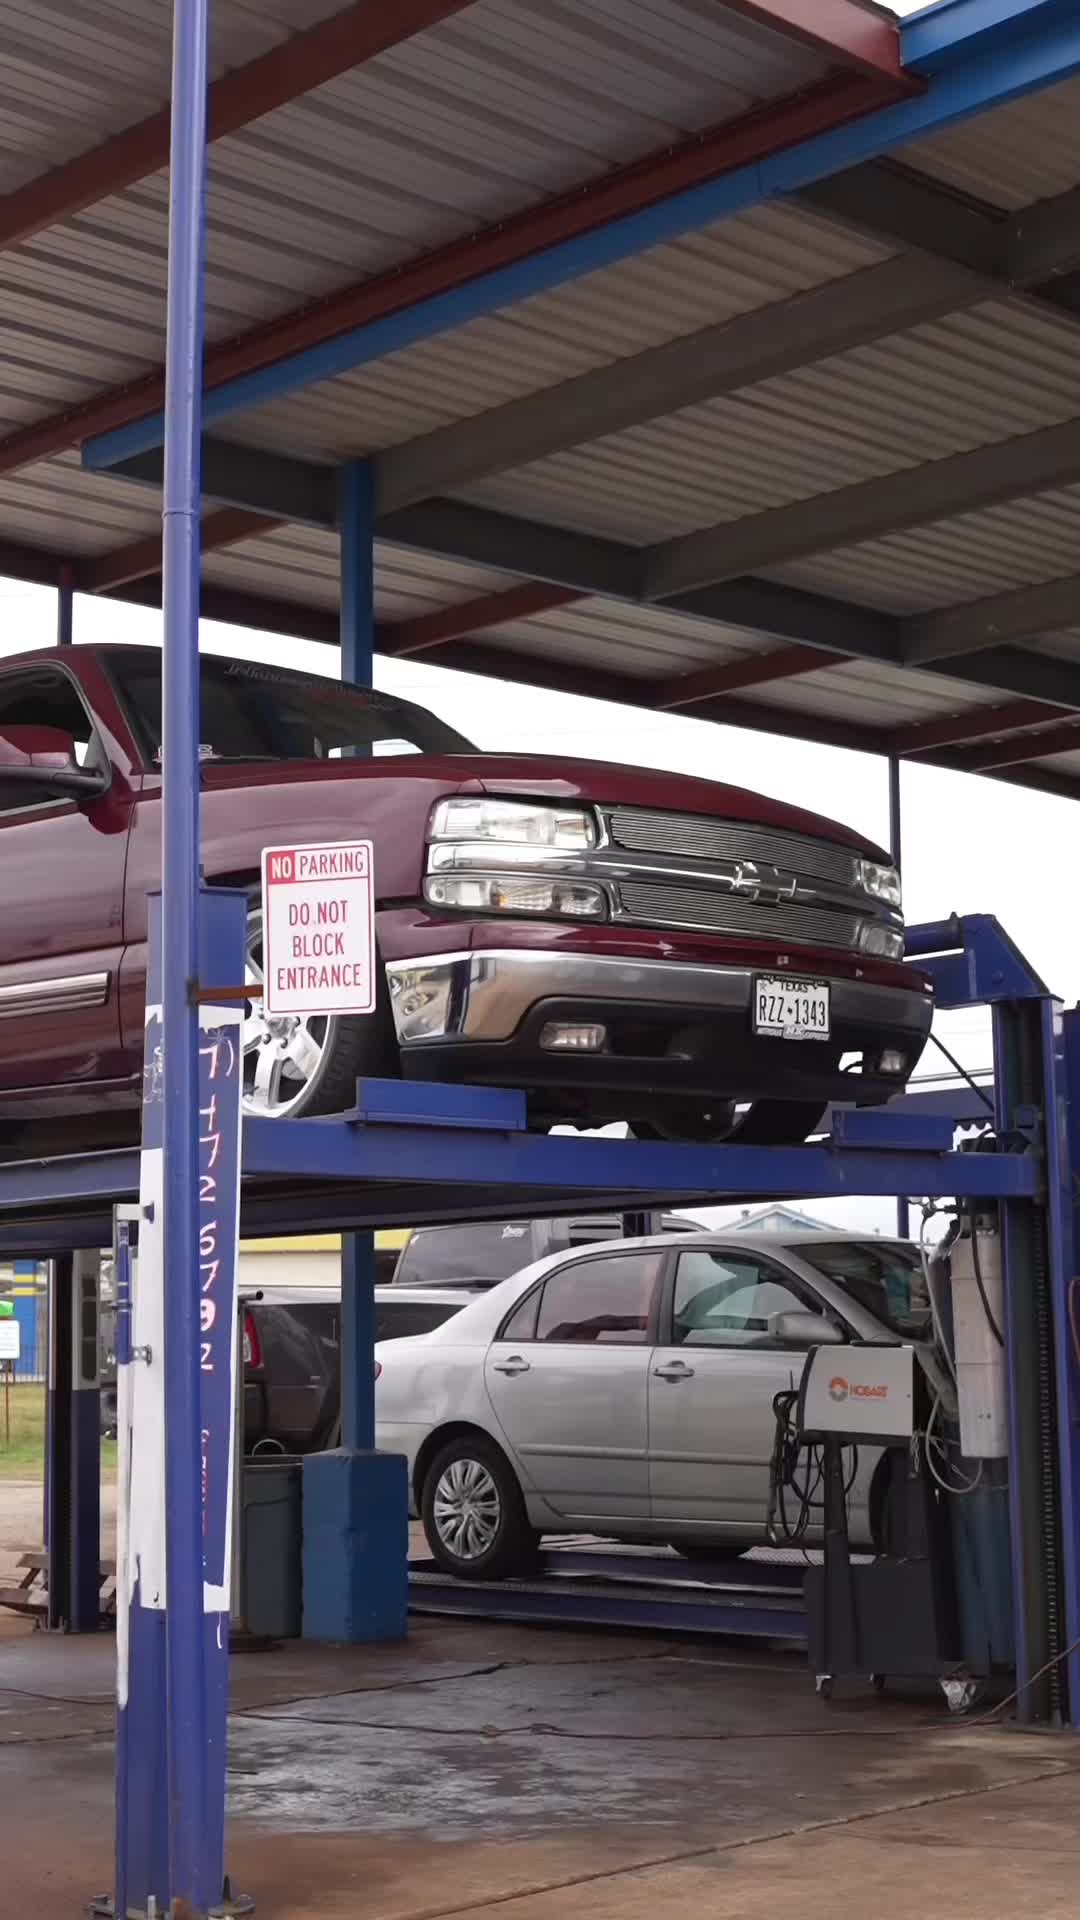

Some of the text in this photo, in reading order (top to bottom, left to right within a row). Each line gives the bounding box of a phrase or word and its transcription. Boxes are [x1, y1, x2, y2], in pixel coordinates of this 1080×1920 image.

[271, 851, 364, 879] NO PARKING
[289, 900, 348, 926] DO NOT
[293, 932, 345, 957] BLOCK
[277, 964, 361, 990] ENTRANCE
[781, 982, 808, 993] TEXAS
